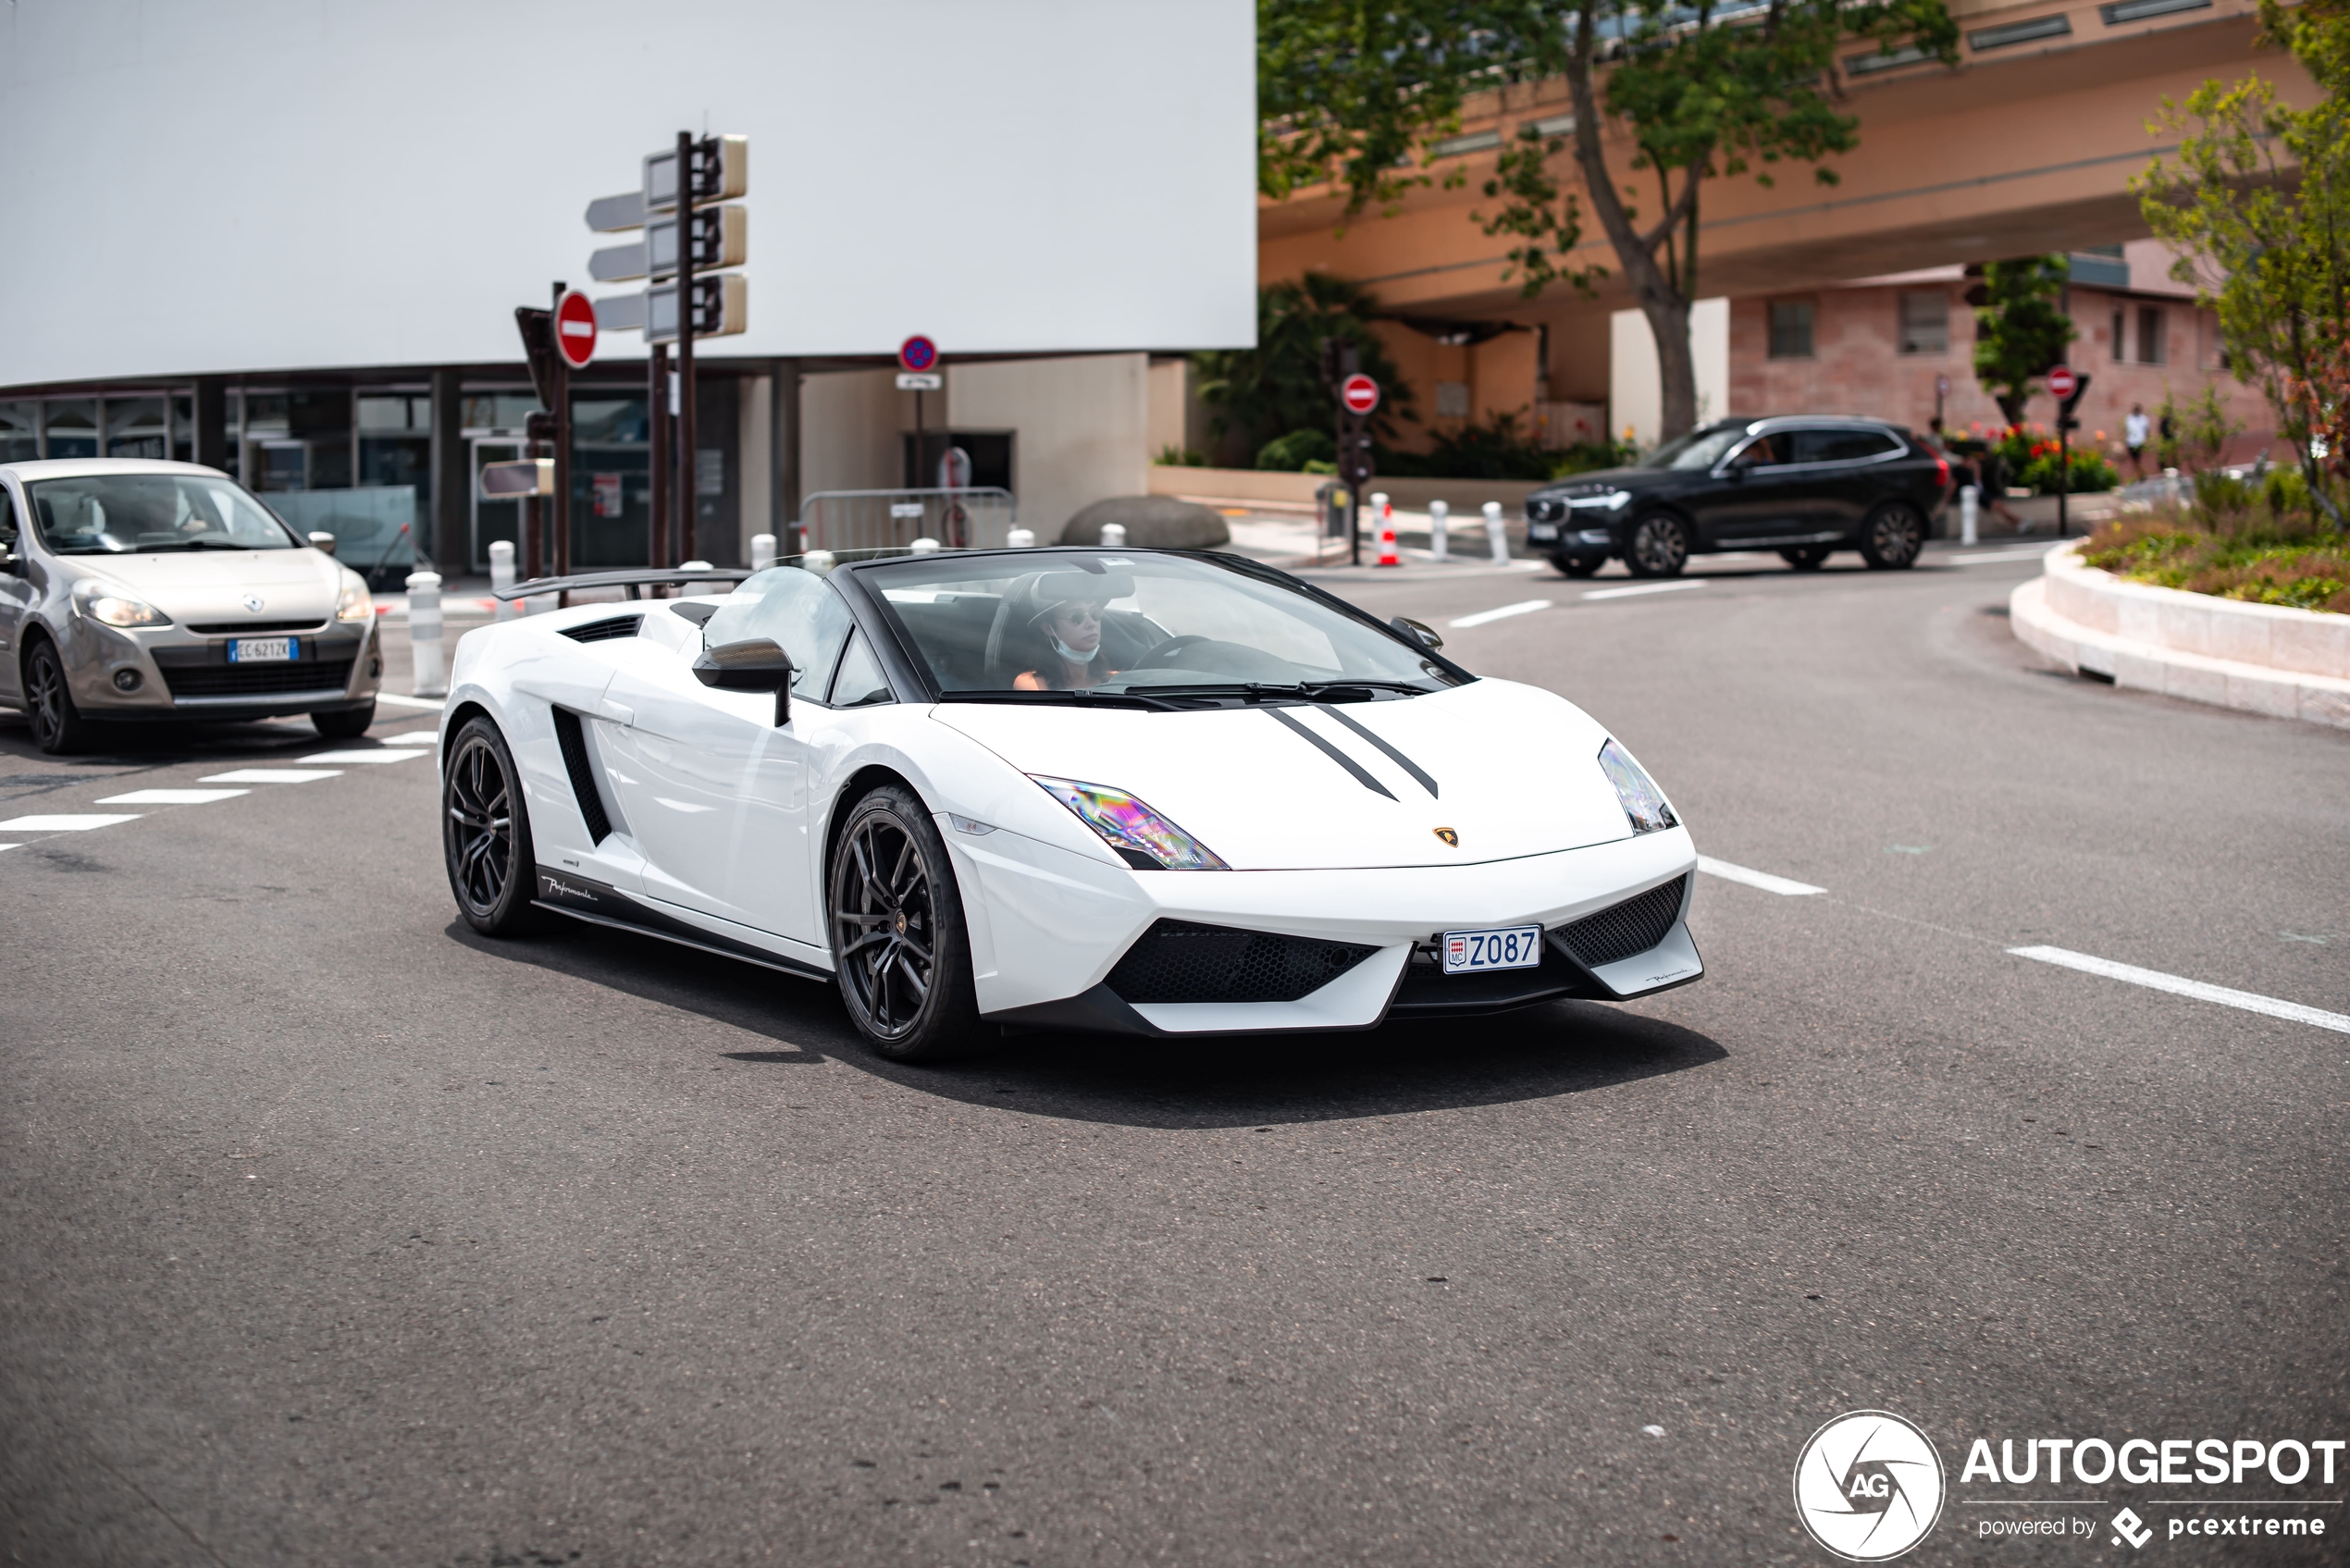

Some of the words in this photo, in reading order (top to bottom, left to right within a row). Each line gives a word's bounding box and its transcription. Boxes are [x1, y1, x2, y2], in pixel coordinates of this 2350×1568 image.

[540, 875, 599, 902] Performante
[1451, 953, 1463, 962] MC
[1470, 932, 1536, 967] Z087
